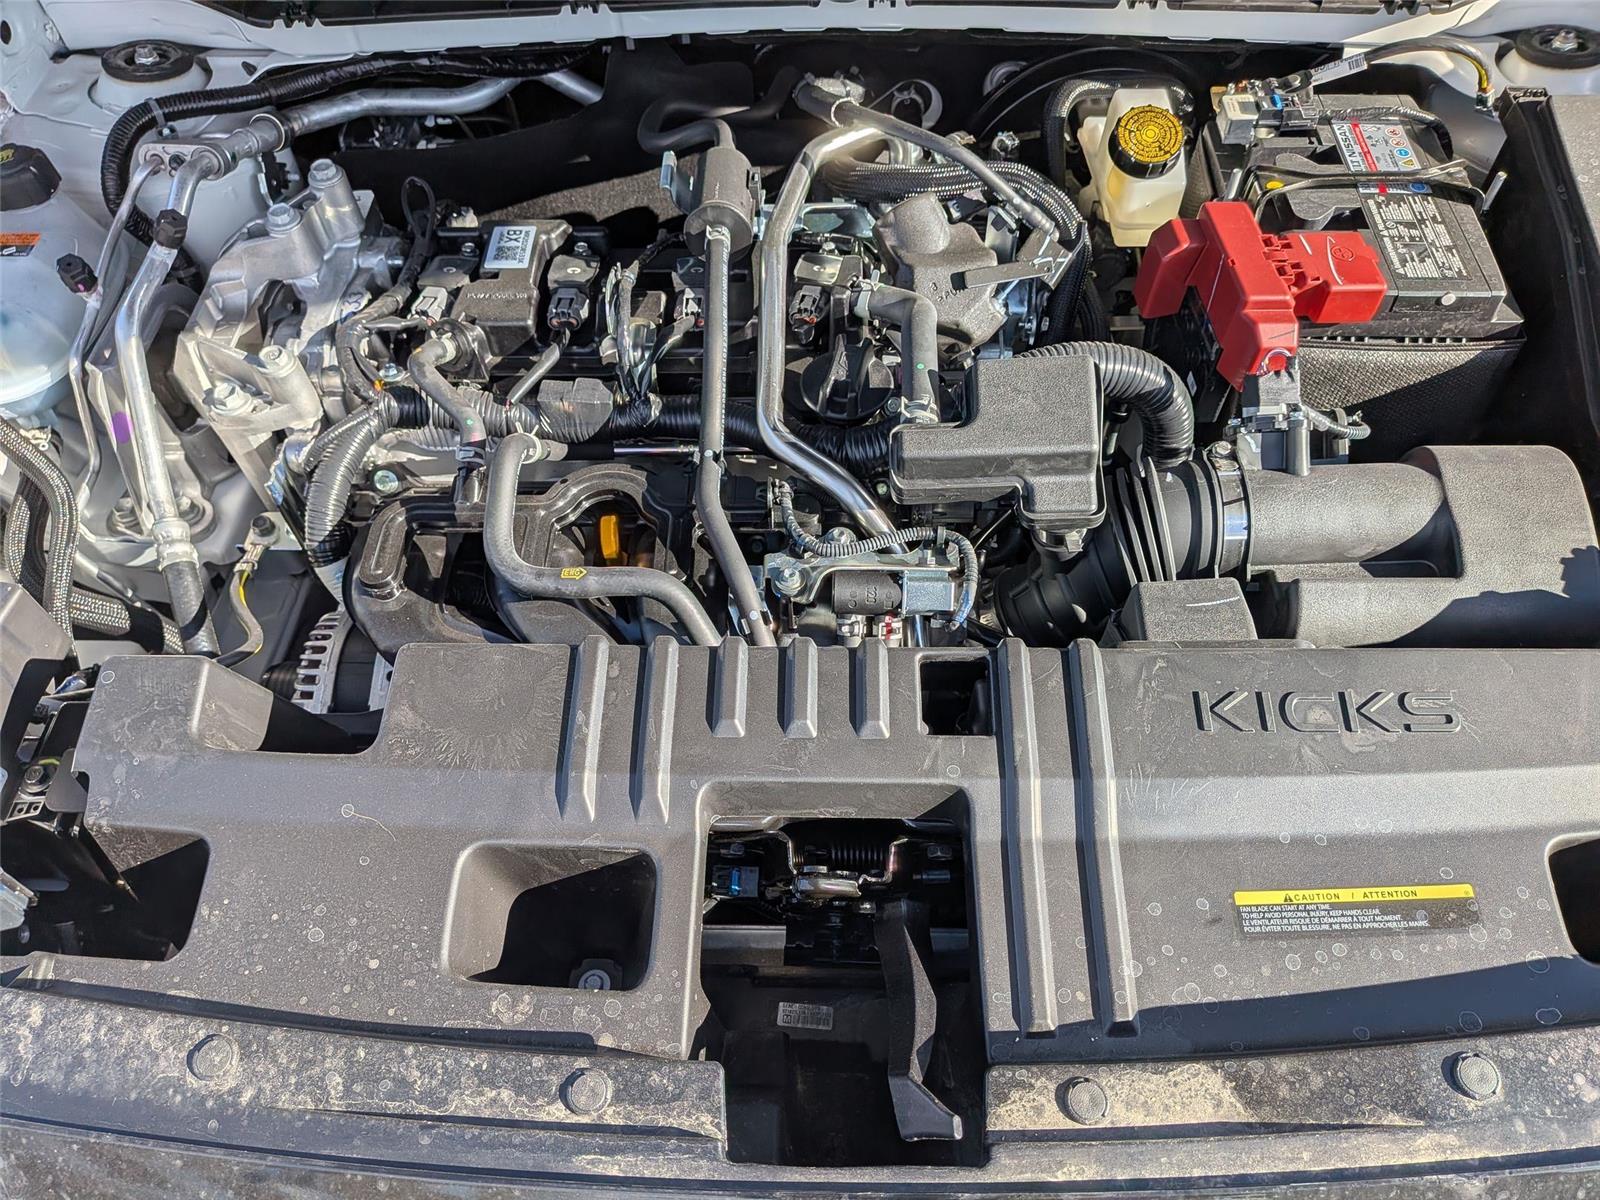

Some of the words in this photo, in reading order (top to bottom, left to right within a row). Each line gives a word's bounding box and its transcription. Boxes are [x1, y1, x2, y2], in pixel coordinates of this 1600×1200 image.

[1337, 124, 1357, 158] NISSAN
[504, 229, 523, 244] BX
[1191, 690, 1462, 733] KICKS
[1294, 892, 1340, 902] CAUTION
[1362, 890, 1418, 899] ATTENTION
[1320, 915, 1354, 923] DÉMARRER
[1261, 924, 1281, 932] ÉVITER
